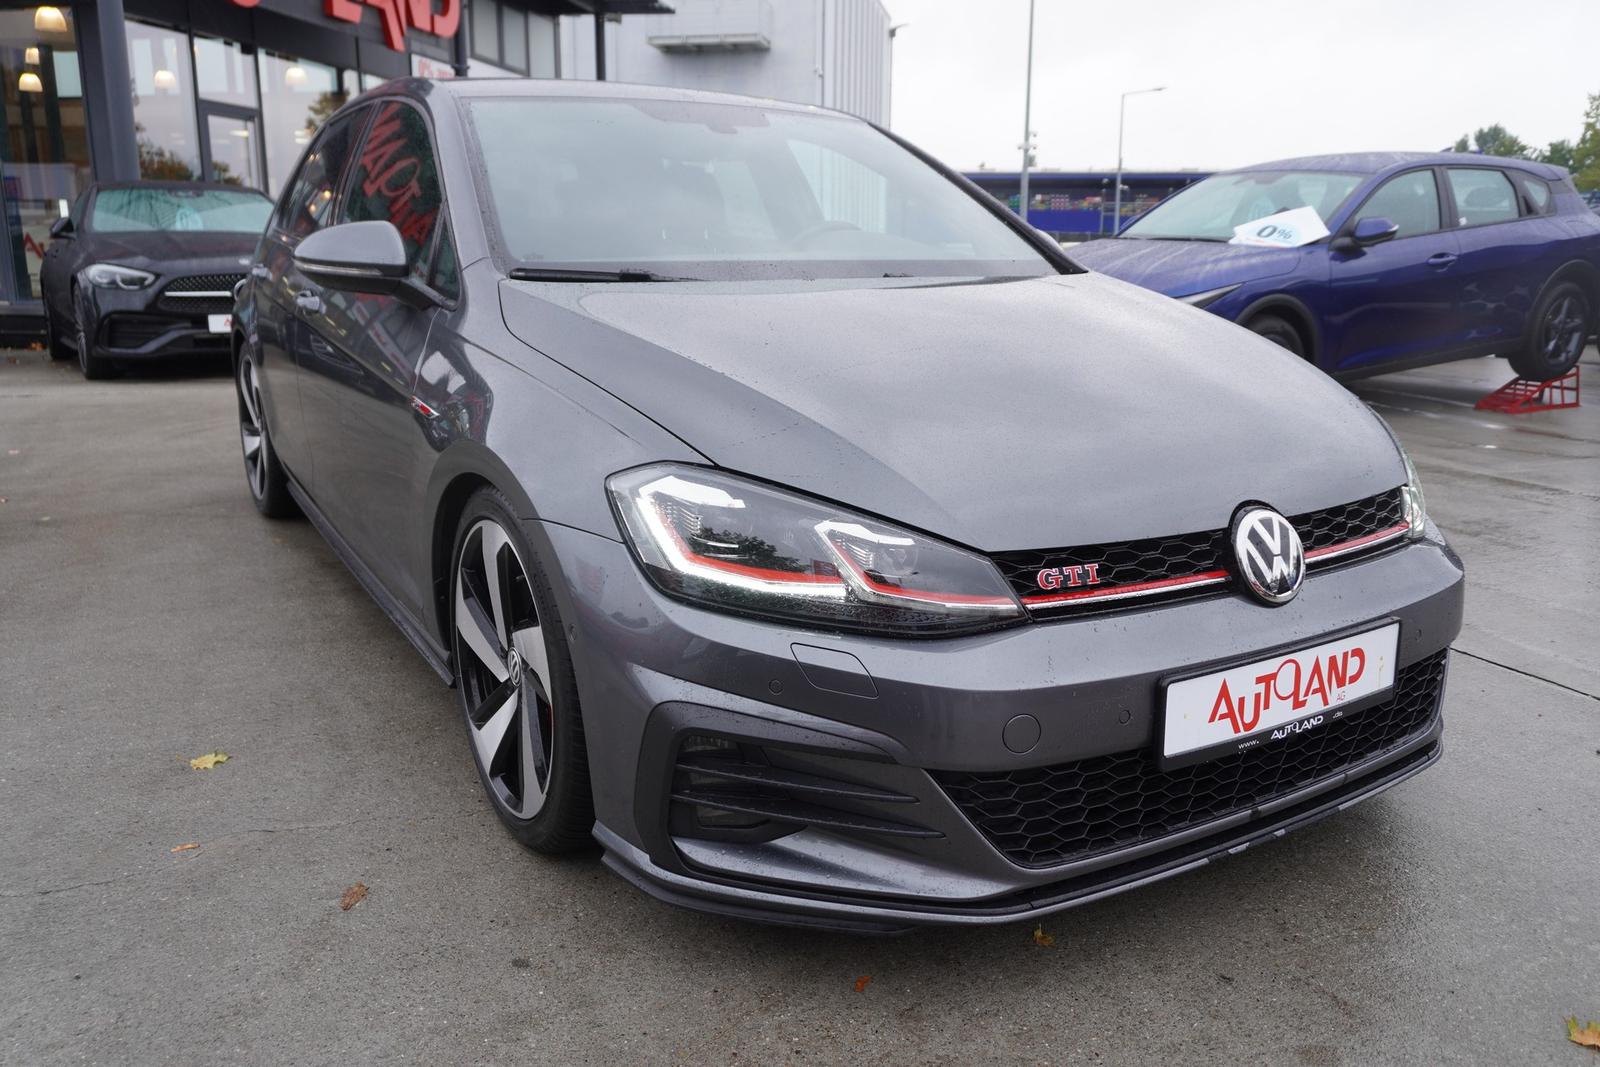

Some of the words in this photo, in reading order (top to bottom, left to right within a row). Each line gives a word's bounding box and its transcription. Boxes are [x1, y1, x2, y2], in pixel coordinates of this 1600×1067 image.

[1257, 225, 1293, 239] 0%
[1237, 509, 1305, 602] VW
[1036, 563, 1100, 591] GTI
[1207, 647, 1366, 734] AUTOLAND
[1237, 739, 1260, 750] www.
[1270, 715, 1324, 740] AUTOLAND
